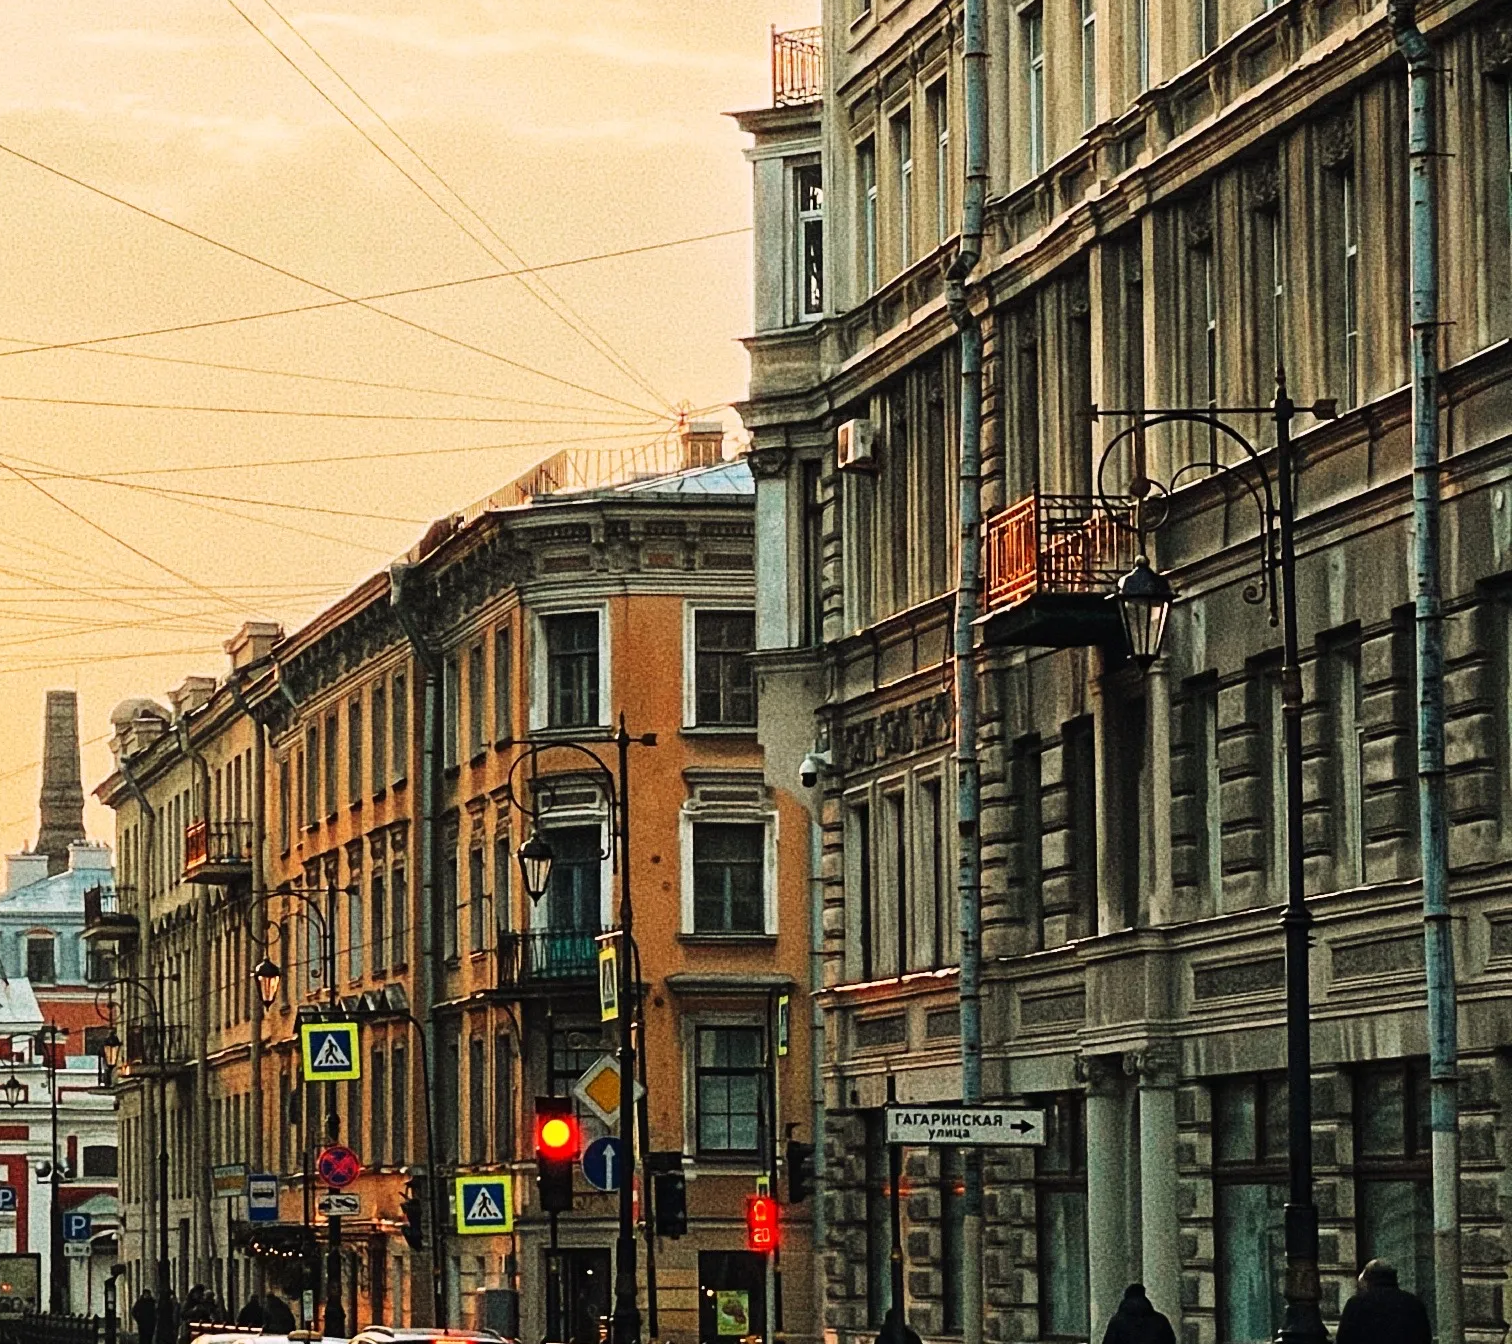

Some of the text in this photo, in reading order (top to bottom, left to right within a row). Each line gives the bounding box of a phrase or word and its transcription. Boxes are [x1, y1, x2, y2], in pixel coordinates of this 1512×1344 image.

[895, 1113, 1003, 1127] ГАГАРИНСКАЯ
[928, 1128, 970, 1139] улица
[71, 1216, 86, 1236] P
